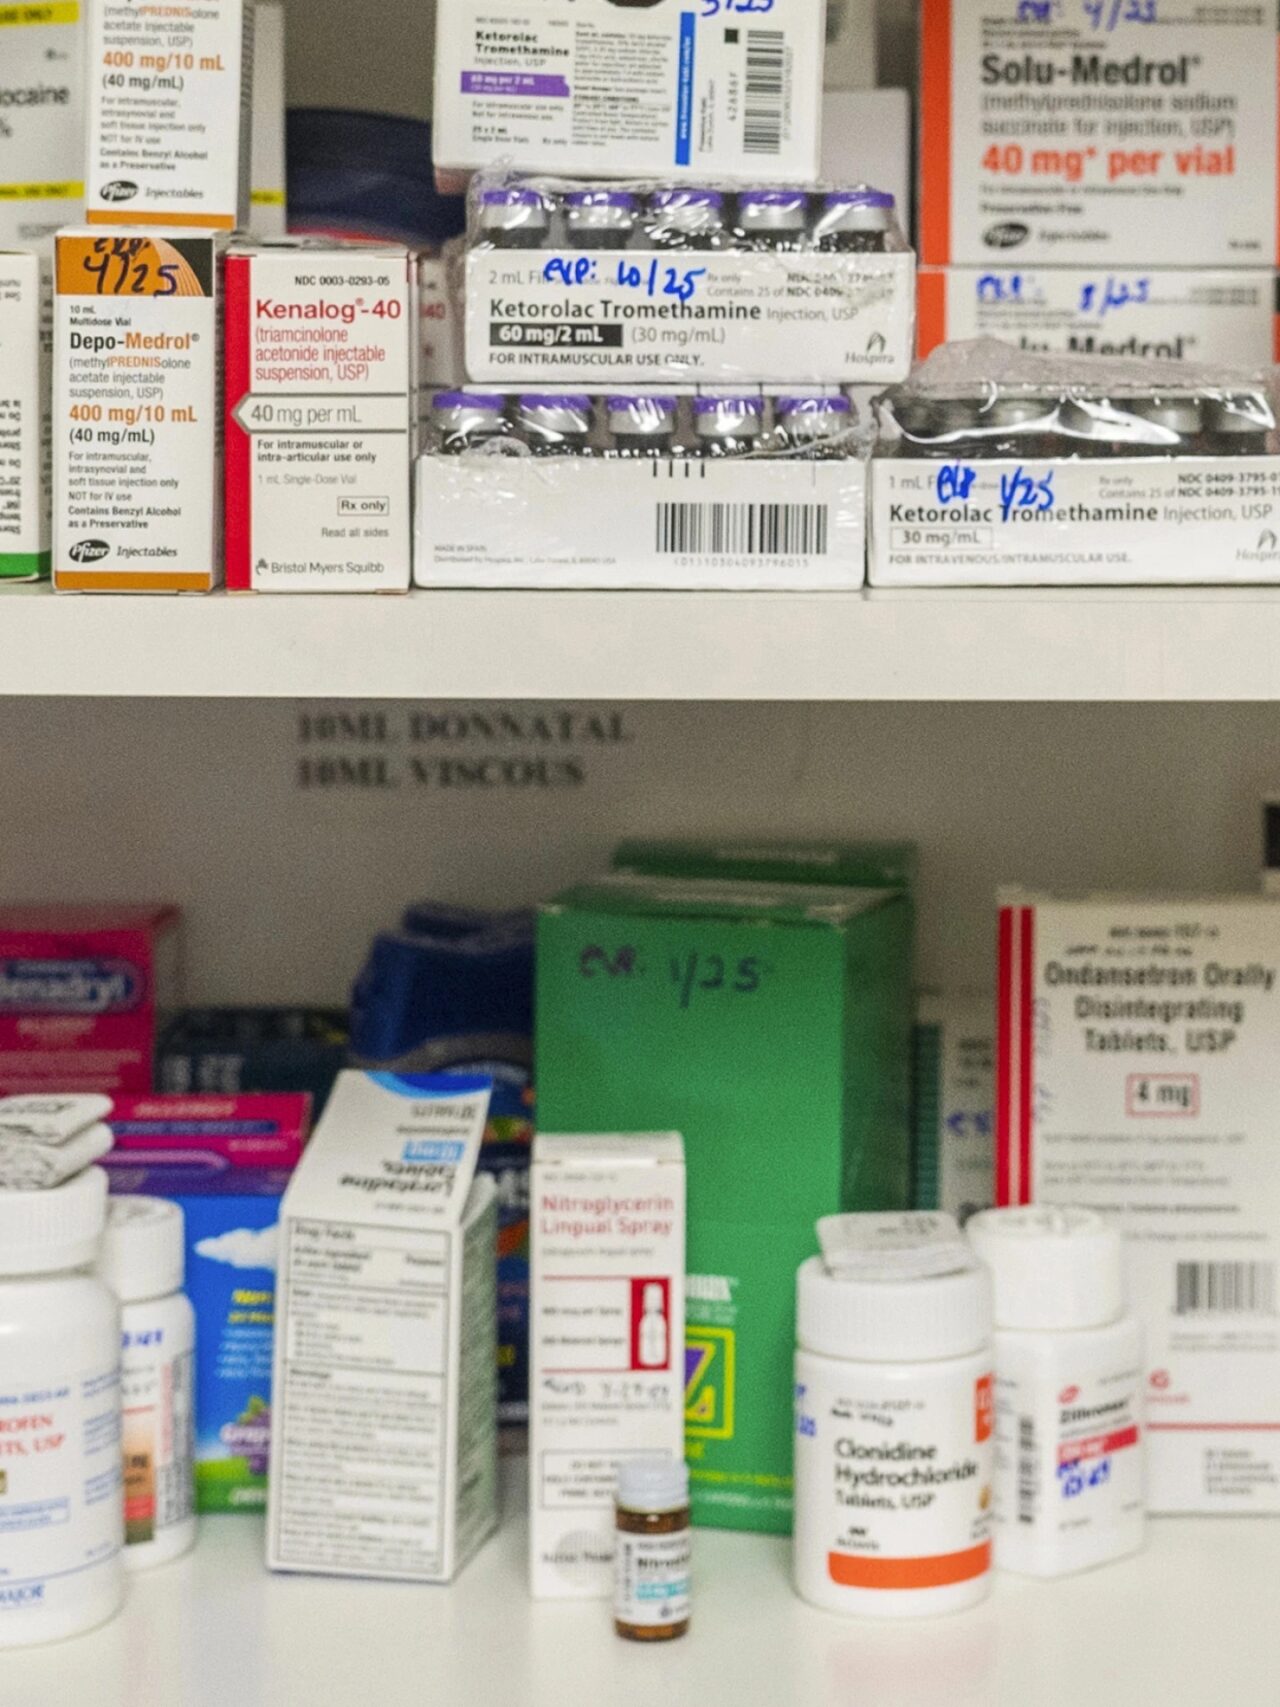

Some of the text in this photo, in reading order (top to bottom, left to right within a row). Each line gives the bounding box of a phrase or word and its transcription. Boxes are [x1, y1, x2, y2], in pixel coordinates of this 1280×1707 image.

[475, 30, 538, 43] Ketorolac
[475, 43, 570, 57] Tromethamine
[104, 52, 225, 72] 400 mg/10 mL
[982, 145, 1022, 174] 40
[1109, 152, 1164, 180] per
[1176, 144, 1234, 174] vial
[295, 277, 390, 286] NDC 0003-0293-05
[491, 300, 593, 318] Ketorolac
[602, 300, 760, 318] Tromethamine
[833, 307, 857, 318] USP
[71, 317, 132, 326] Multidose Vial
[256, 327, 348, 342] (triamcinolone
[500, 326, 725, 345] 60 mg/2 mL (30 mg/mL)
[70, 356, 191, 369] (methylPREDNISolone
[256, 347, 385, 364] acetonide injectable
[490, 352, 660, 364] FOR INTRAMUSCULAR USE
[70, 371, 165, 385] acetate injectable
[256, 366, 369, 382] suspension, USP)
[70, 387, 163, 399] suspension, USP)
[70, 405, 197, 425] 400 mg/10 mL
[251, 405, 361, 426] 40 mg per mL
[70, 428, 155, 446] (40 mg/mL)
[258, 441, 274, 449] For
[277, 441, 350, 449] intramuscular
[258, 453, 330, 461] intra-articular
[356, 453, 377, 463] only
[1179, 473, 1202, 483] NDC
[1178, 487, 1202, 497] NDC
[341, 500, 386, 512] Rx only
[891, 505, 1272, 522] Ketorolac Tromethamine Injection, USP
[903, 531, 981, 545] 30 mg/mL
[117, 546, 178, 558] Injectables
[271, 562, 384, 575] Bristol Myers Squibb
[542, 1195, 675, 1216] Nitroglycerin
[542, 1217, 672, 1237] Lingual Spray
[836, 1438, 937, 1461] Clonidine
